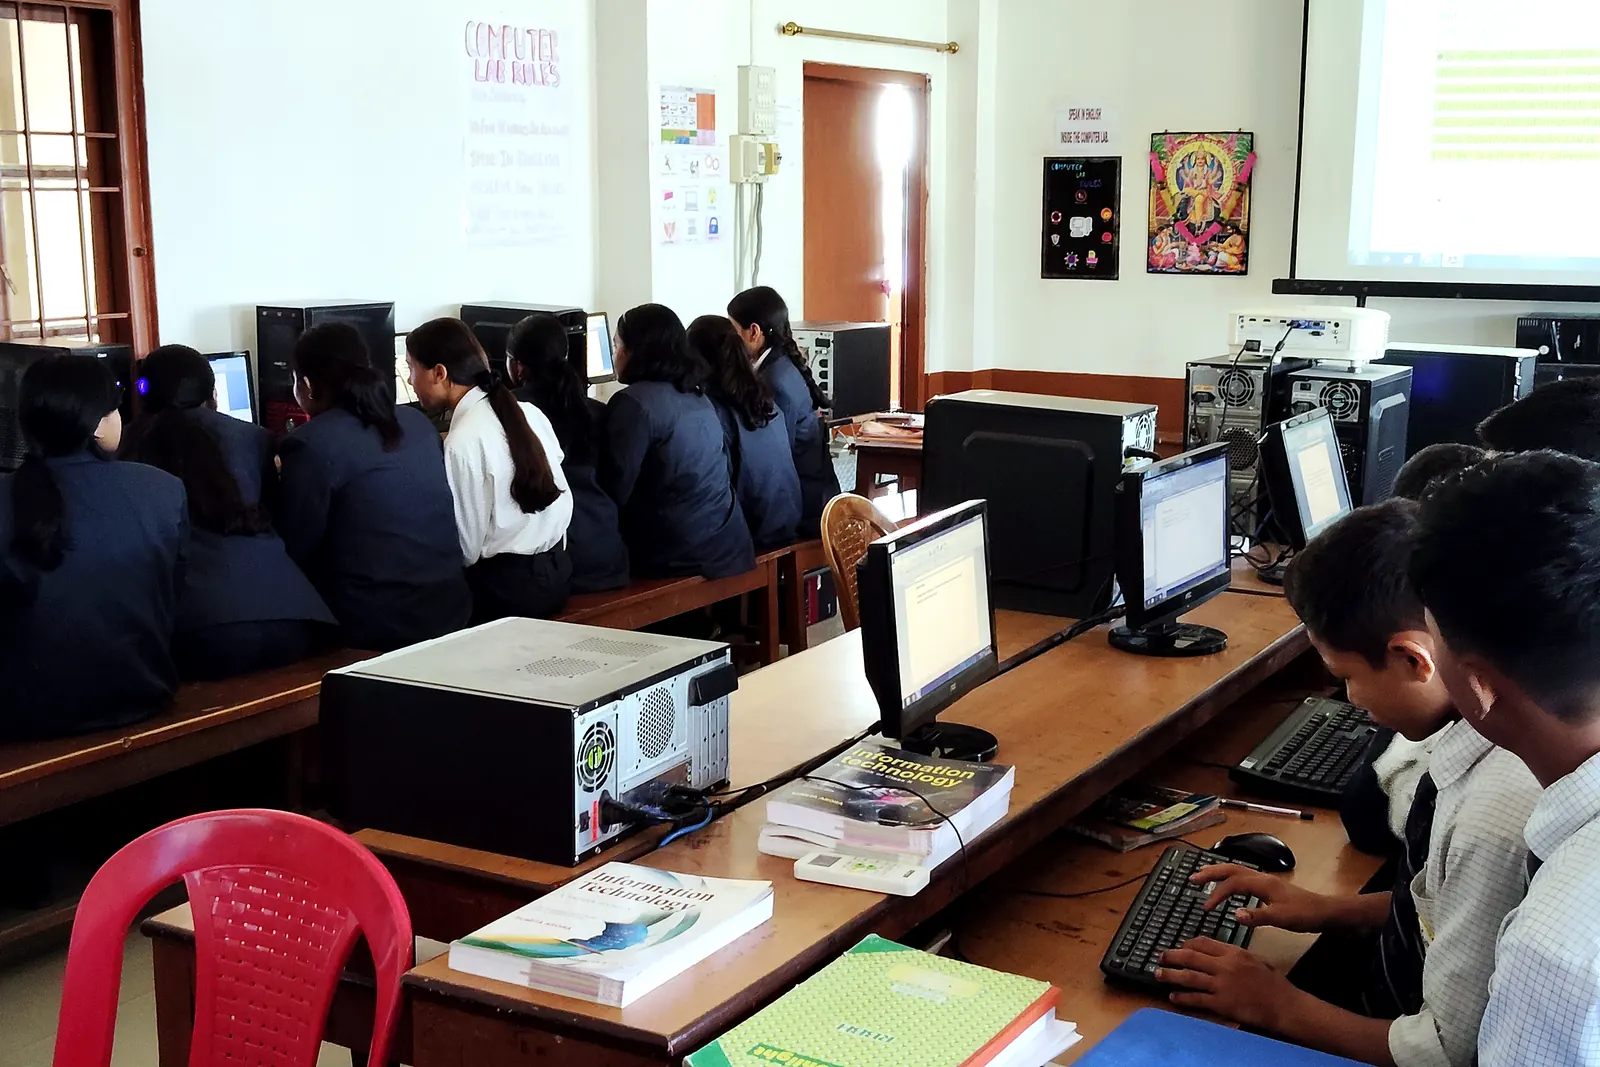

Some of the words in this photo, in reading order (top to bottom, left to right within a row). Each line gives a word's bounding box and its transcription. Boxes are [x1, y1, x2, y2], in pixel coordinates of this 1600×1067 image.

[465, 20, 559, 63] COMPUTER
[474, 58, 505, 84] LAB
[512, 60, 560, 88] RULES
[1051, 163, 1083, 171] COMPUTER
[577, 880, 697, 912] Technology
[590, 871, 715, 902] Information
